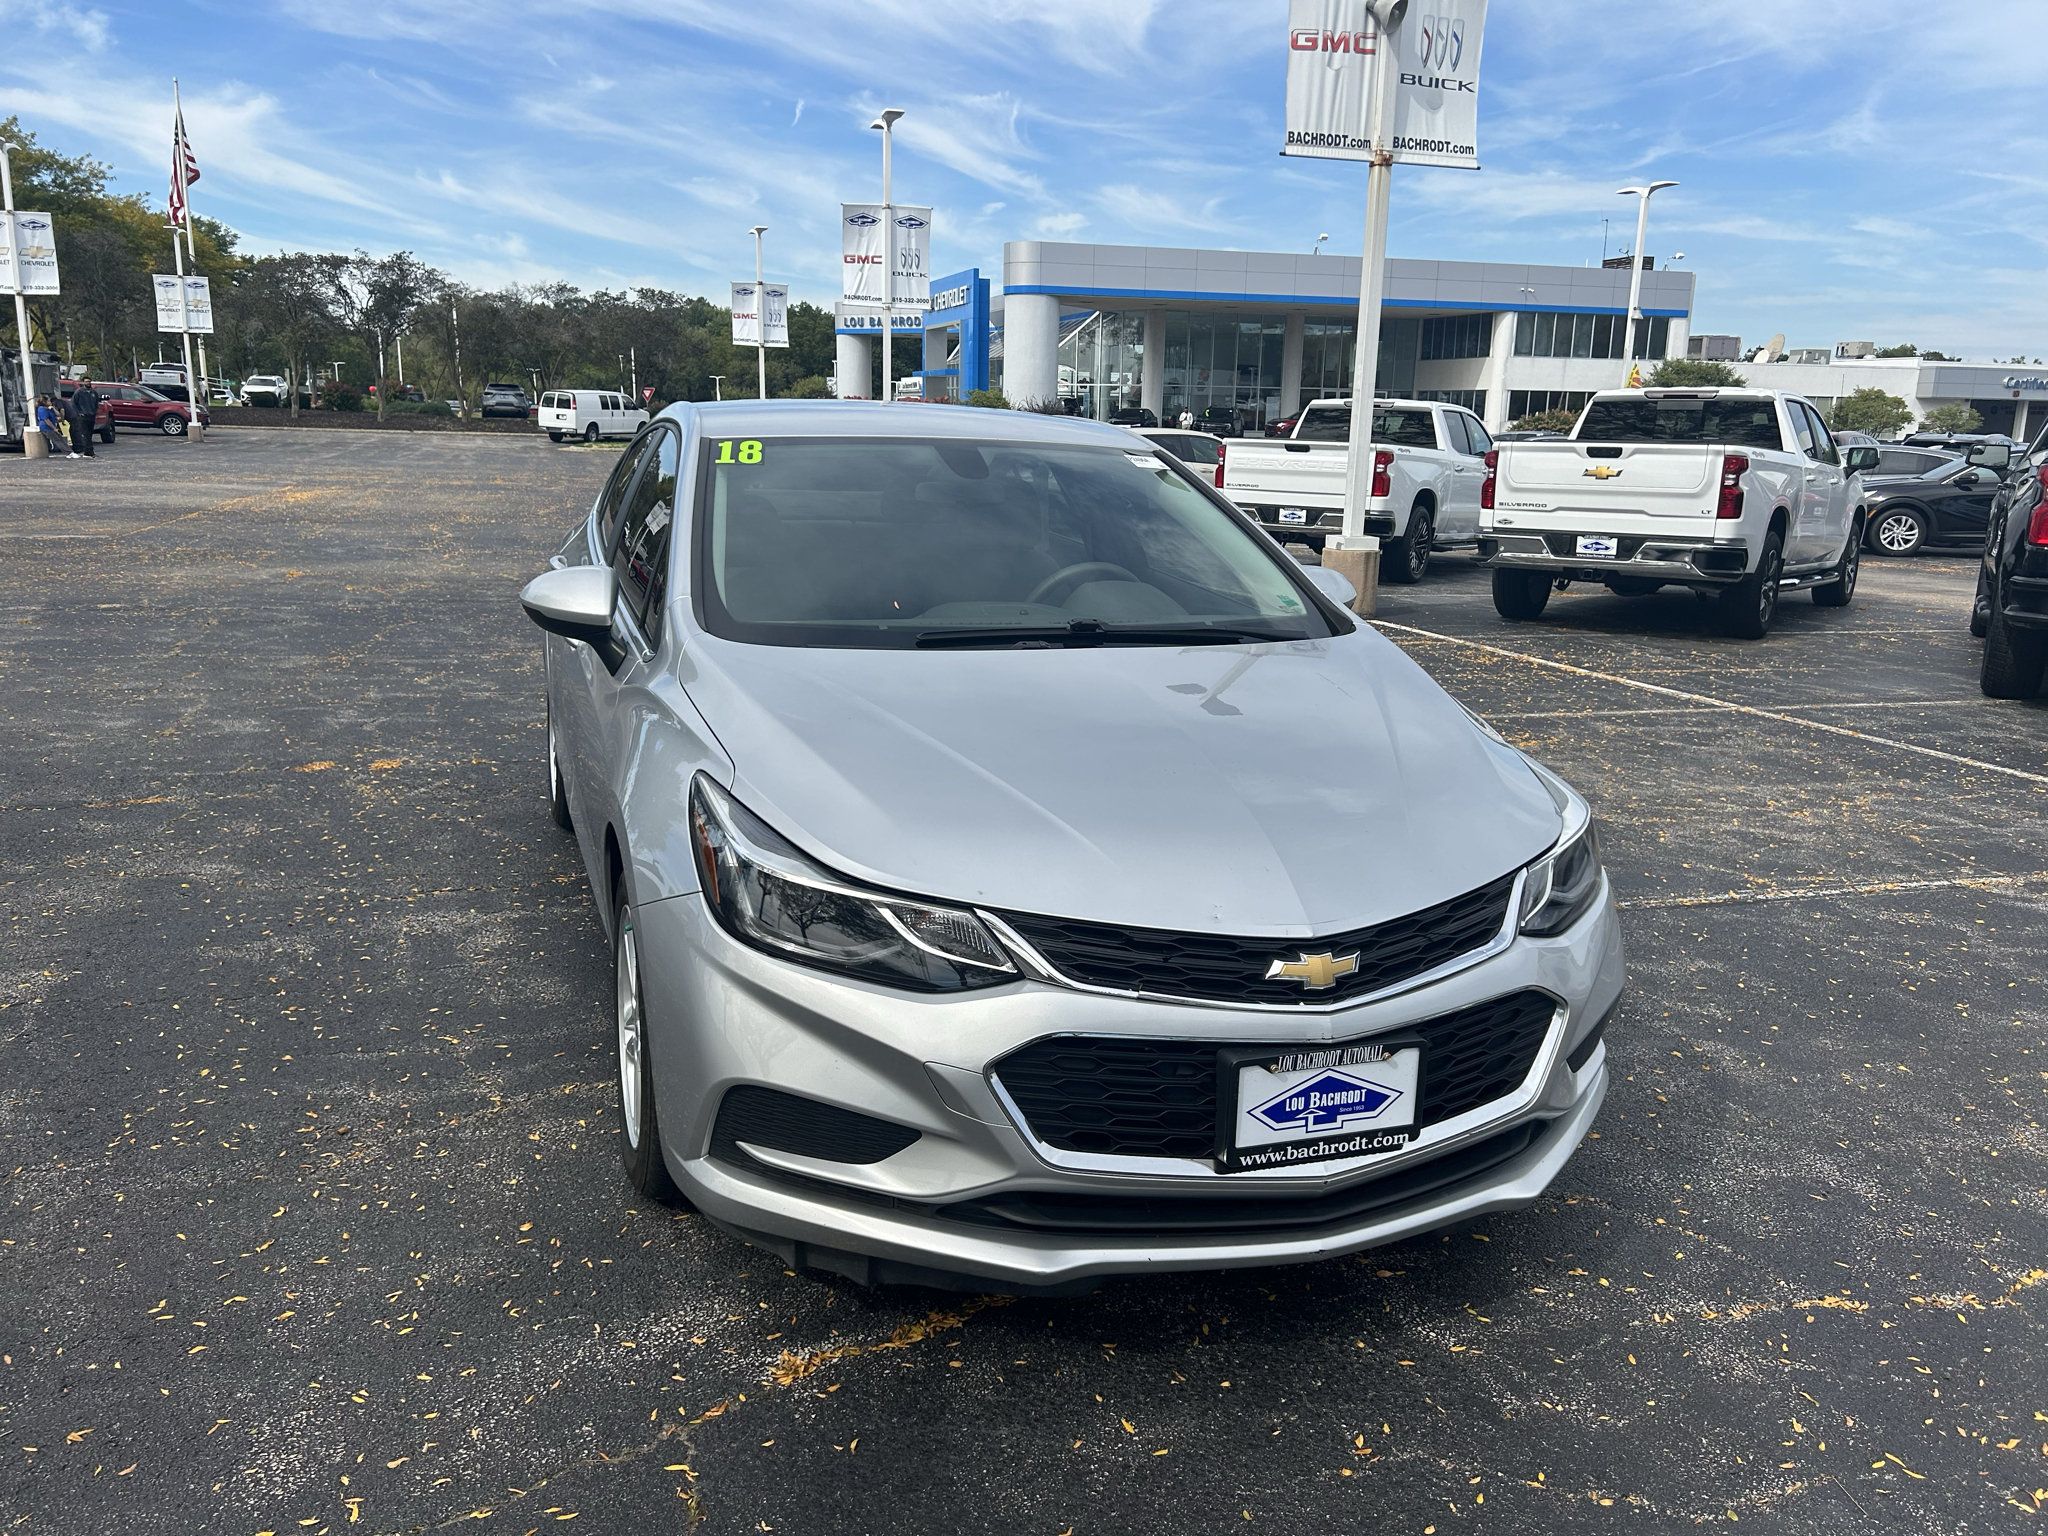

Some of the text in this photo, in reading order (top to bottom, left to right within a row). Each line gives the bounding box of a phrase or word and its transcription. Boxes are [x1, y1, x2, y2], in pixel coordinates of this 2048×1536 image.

[1290, 28, 1377, 55] GMC
[1400, 72, 1475, 93] BUICK
[1287, 130, 1371, 149] BACHRODT.com
[1392, 136, 1475, 155] BACHRODT.com
[843, 254, 882, 265] GMC
[892, 270, 929, 279] BUICK
[844, 294, 882, 302] BACHRODT.com
[934, 285, 968, 311] CHEVROLET
[844, 316, 923, 328] LOU BAHROD
[715, 440, 763, 464] 18
[1232, 457, 1347, 471] CHEVROLE
[1277, 1044, 1385, 1072] LOU BACHRODT AUTOMALL
[1286, 1088, 1367, 1112] LOU BACHRODT
[1239, 1132, 1409, 1167] www.bachrodt.com
